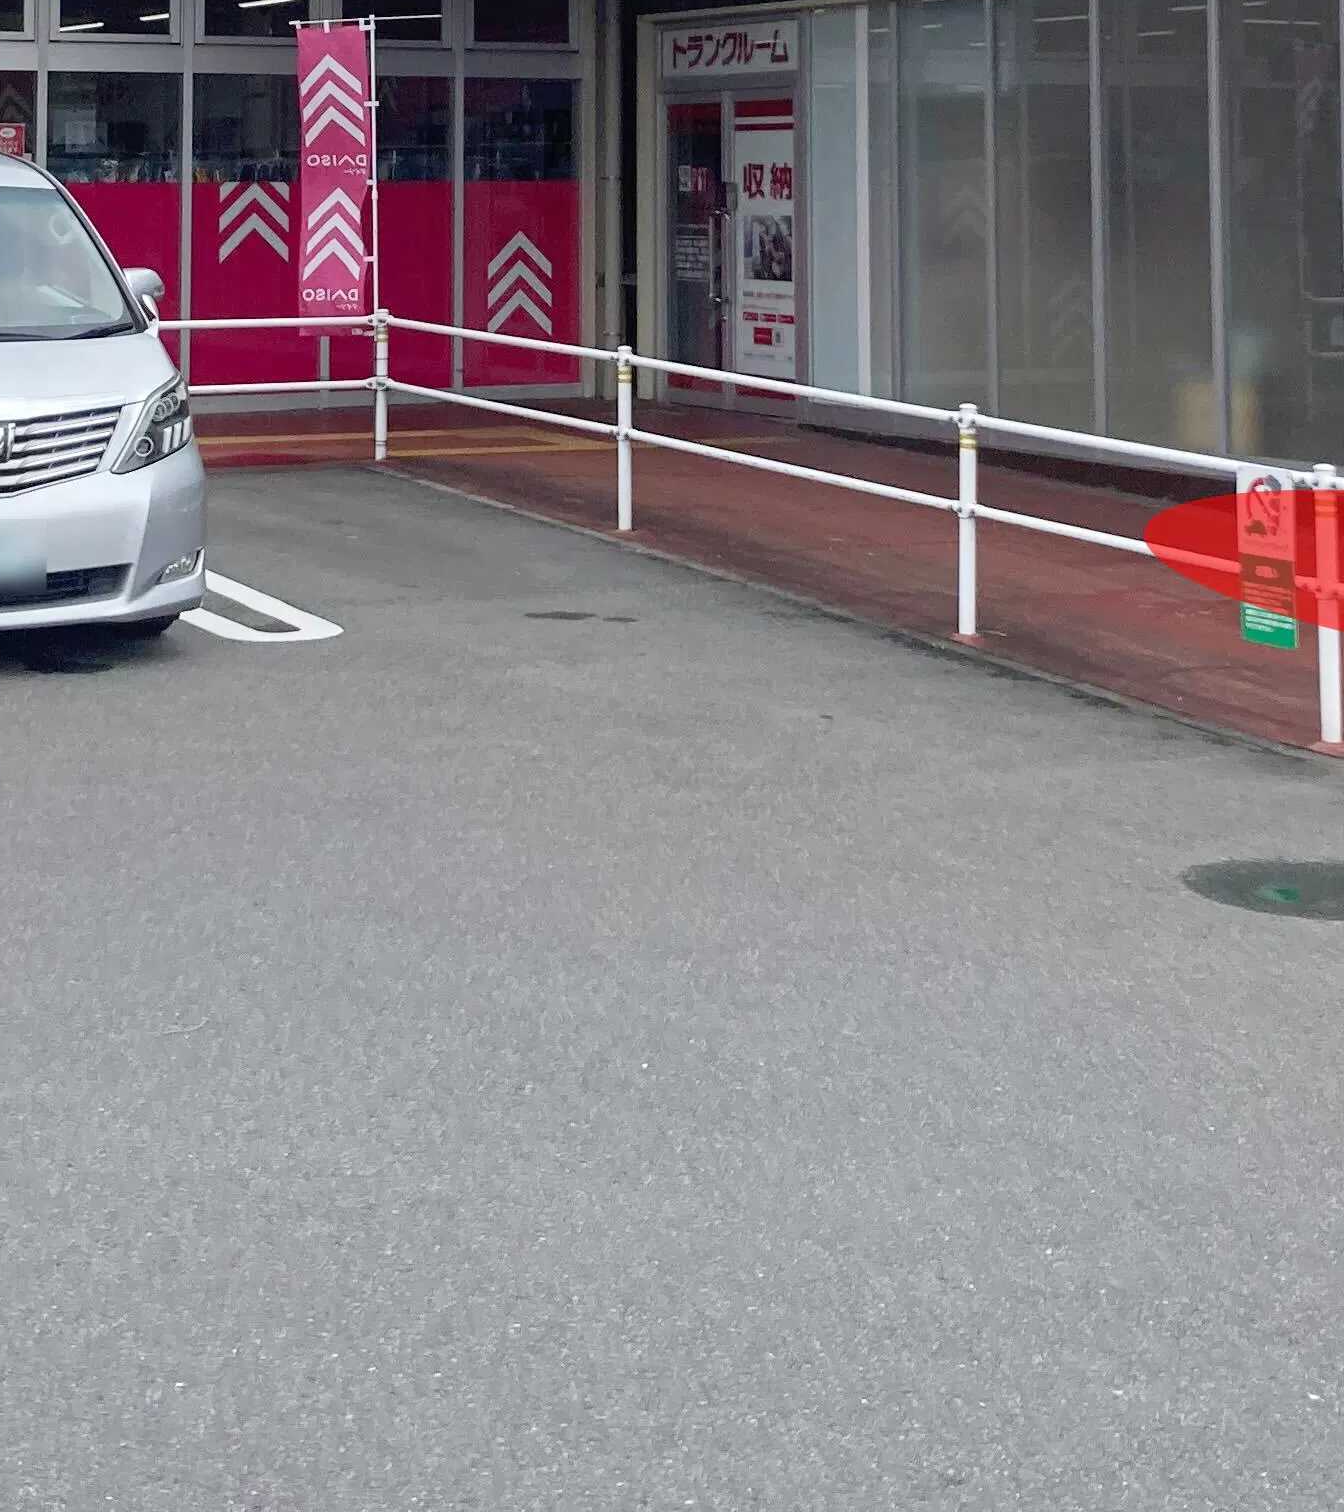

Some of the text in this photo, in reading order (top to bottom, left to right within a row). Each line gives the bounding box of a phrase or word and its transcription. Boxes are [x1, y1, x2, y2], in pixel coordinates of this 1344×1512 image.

[672, 29, 788, 69] トランクルーム
[743, 162, 792, 200] 収納
